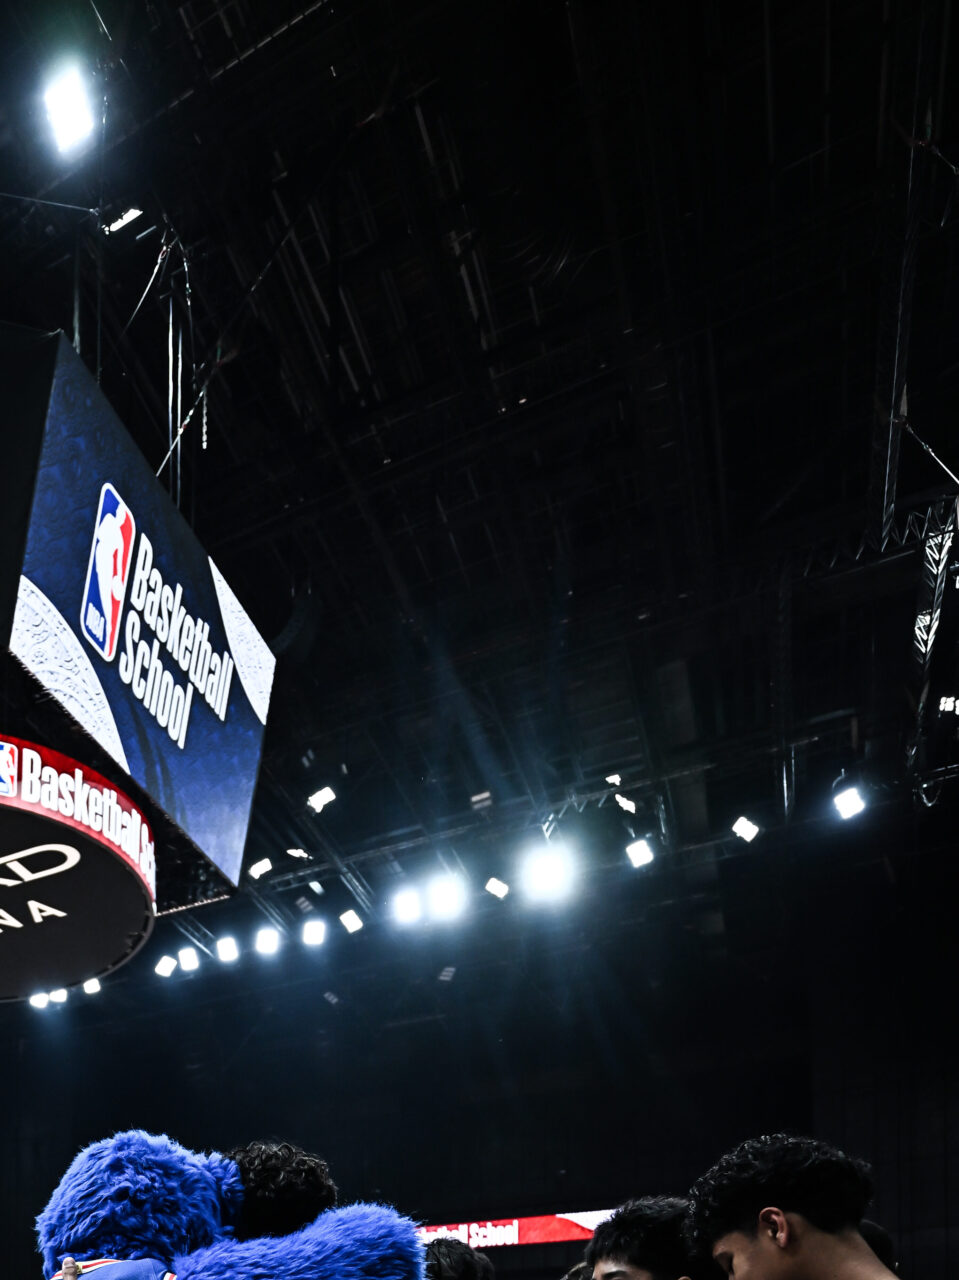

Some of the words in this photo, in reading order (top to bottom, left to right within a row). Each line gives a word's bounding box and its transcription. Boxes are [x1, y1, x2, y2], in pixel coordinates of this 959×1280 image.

[118, 609, 194, 750] School
[130, 532, 234, 722] Basketball
[21, 747, 142, 865] Basketball
[468, 1219, 519, 1248] School
